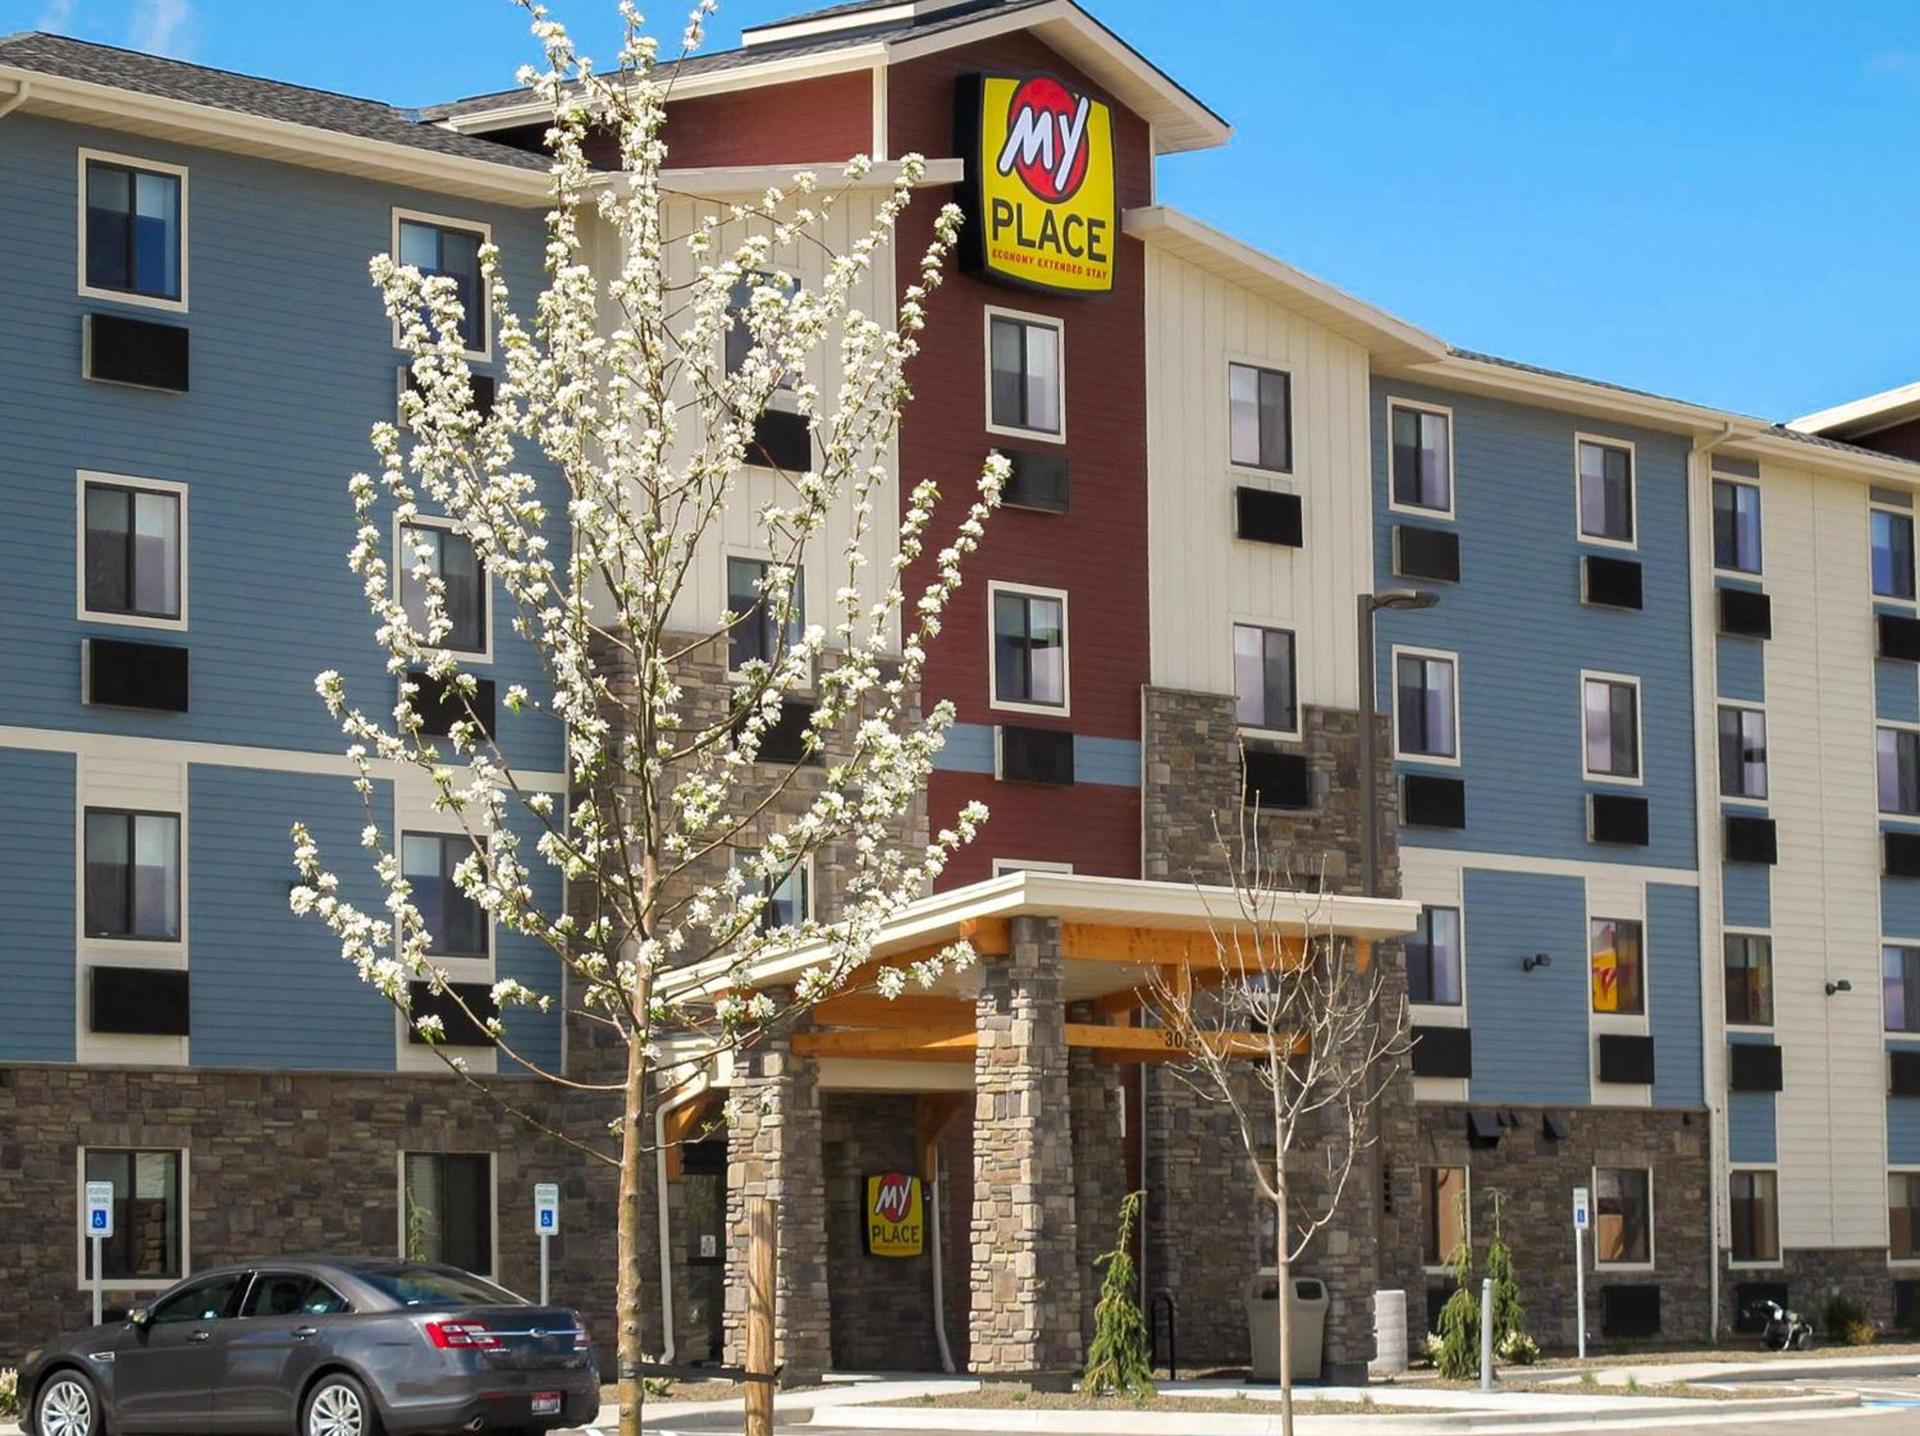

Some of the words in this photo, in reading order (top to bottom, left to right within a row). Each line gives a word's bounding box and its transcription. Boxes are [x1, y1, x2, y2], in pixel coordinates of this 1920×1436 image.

[991, 198, 1107, 263] PLACE
[992, 248, 1034, 264] ECONOMY
[1037, 257, 1083, 275] EXTENDED
[1086, 267, 1107, 280] STAY
[872, 1225, 920, 1244] PLACE
